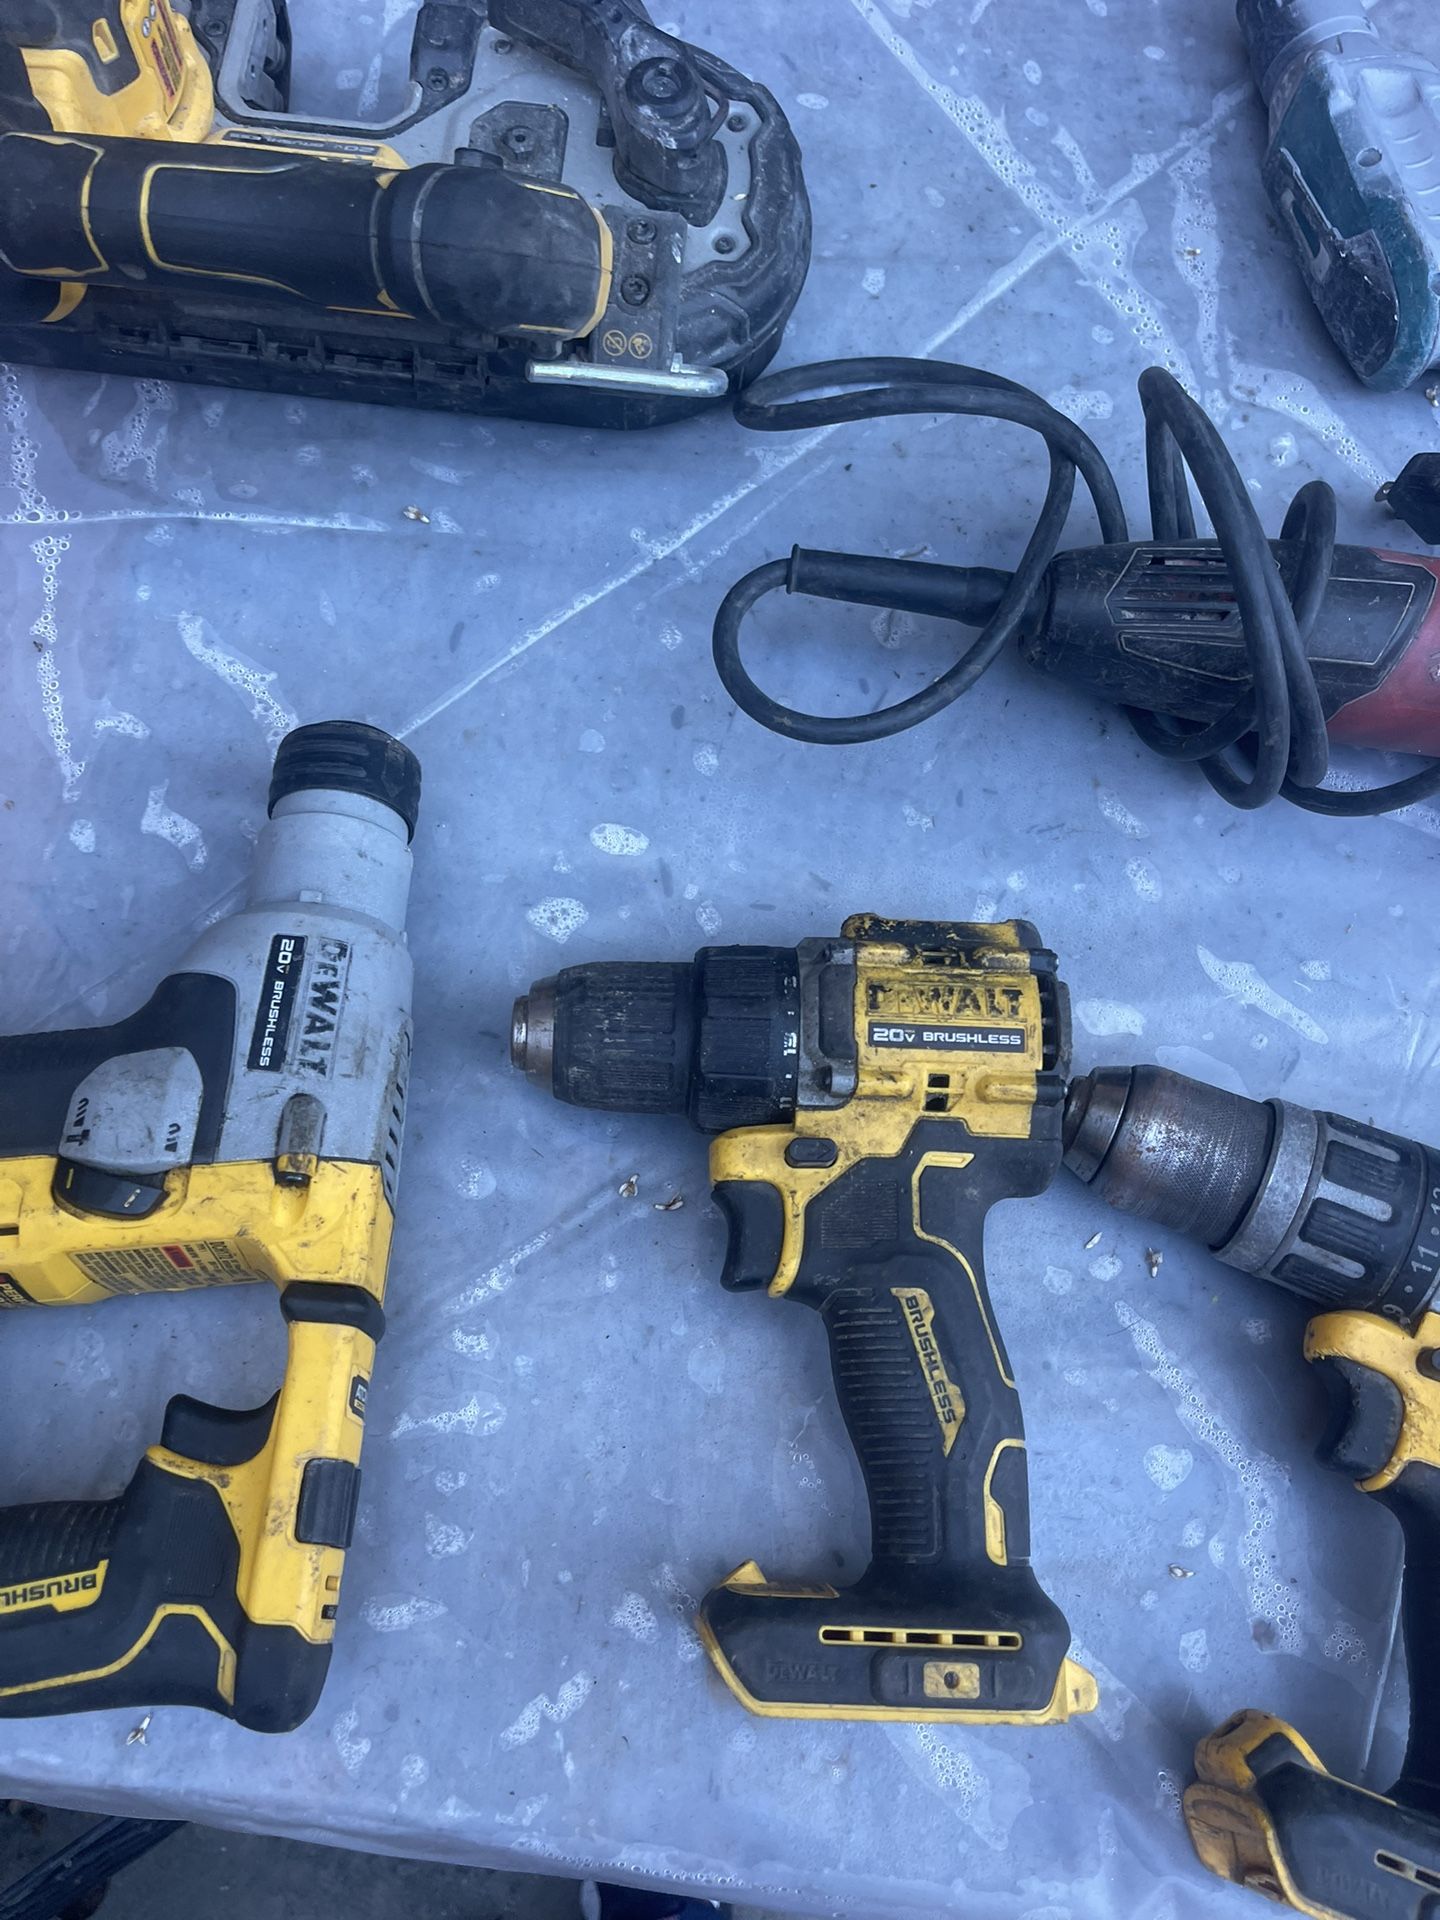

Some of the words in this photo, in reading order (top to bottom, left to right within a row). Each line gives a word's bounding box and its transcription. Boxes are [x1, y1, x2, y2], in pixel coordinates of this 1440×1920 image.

[259, 981, 285, 1067] BRUSHLESS
[923, 1031, 1022, 1045] BRUSHLESS
[1411, 1245, 1439, 1272] 11
[905, 1295, 957, 1424] BRUSHLESS
